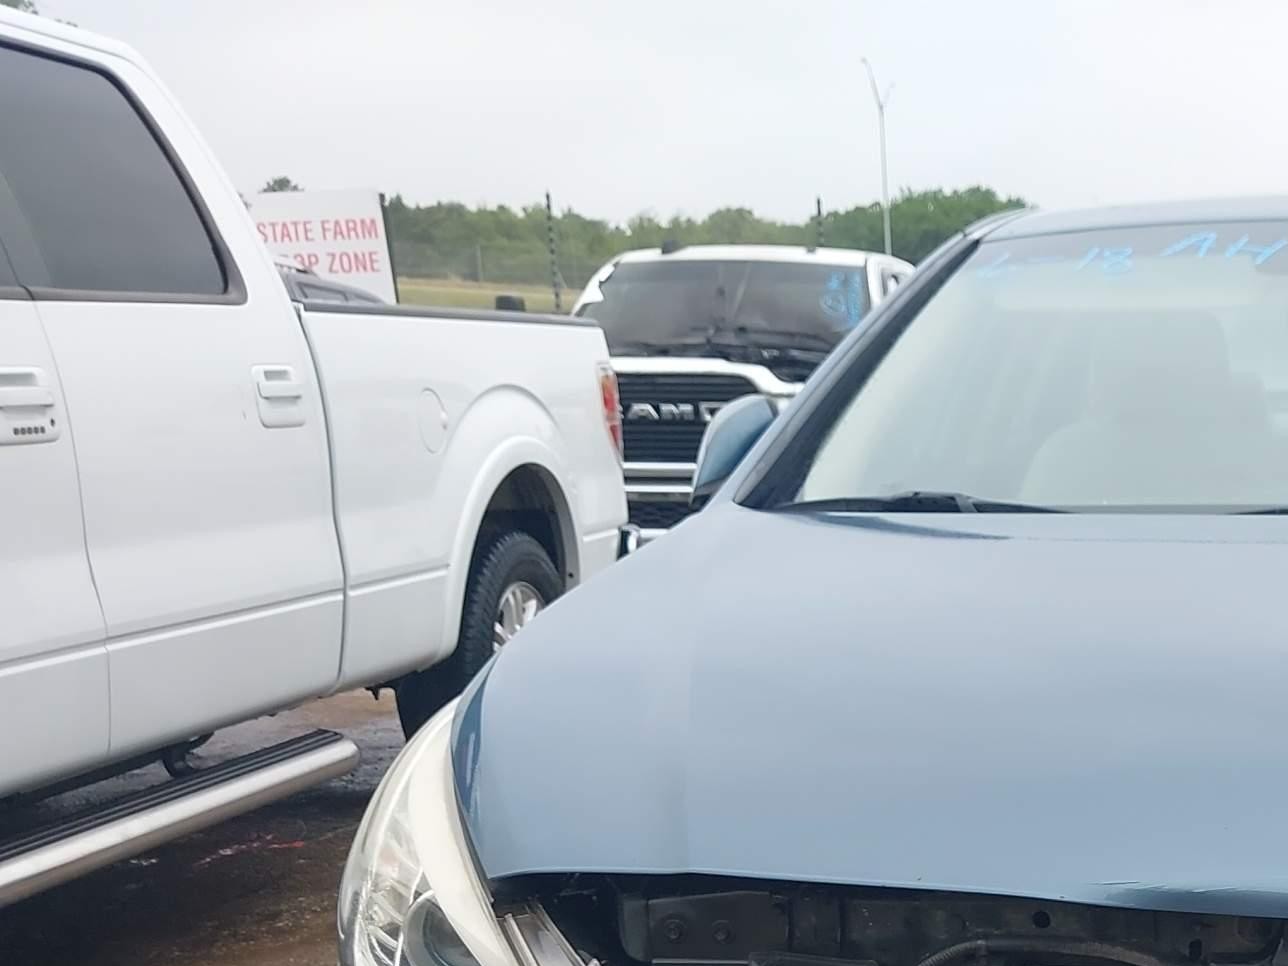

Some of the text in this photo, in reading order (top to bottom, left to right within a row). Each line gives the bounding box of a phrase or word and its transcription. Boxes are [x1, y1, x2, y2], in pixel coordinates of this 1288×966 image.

[257, 219, 379, 243] STATE FARM
[328, 251, 381, 274] ZONE
[617, 403, 695, 420] AM
